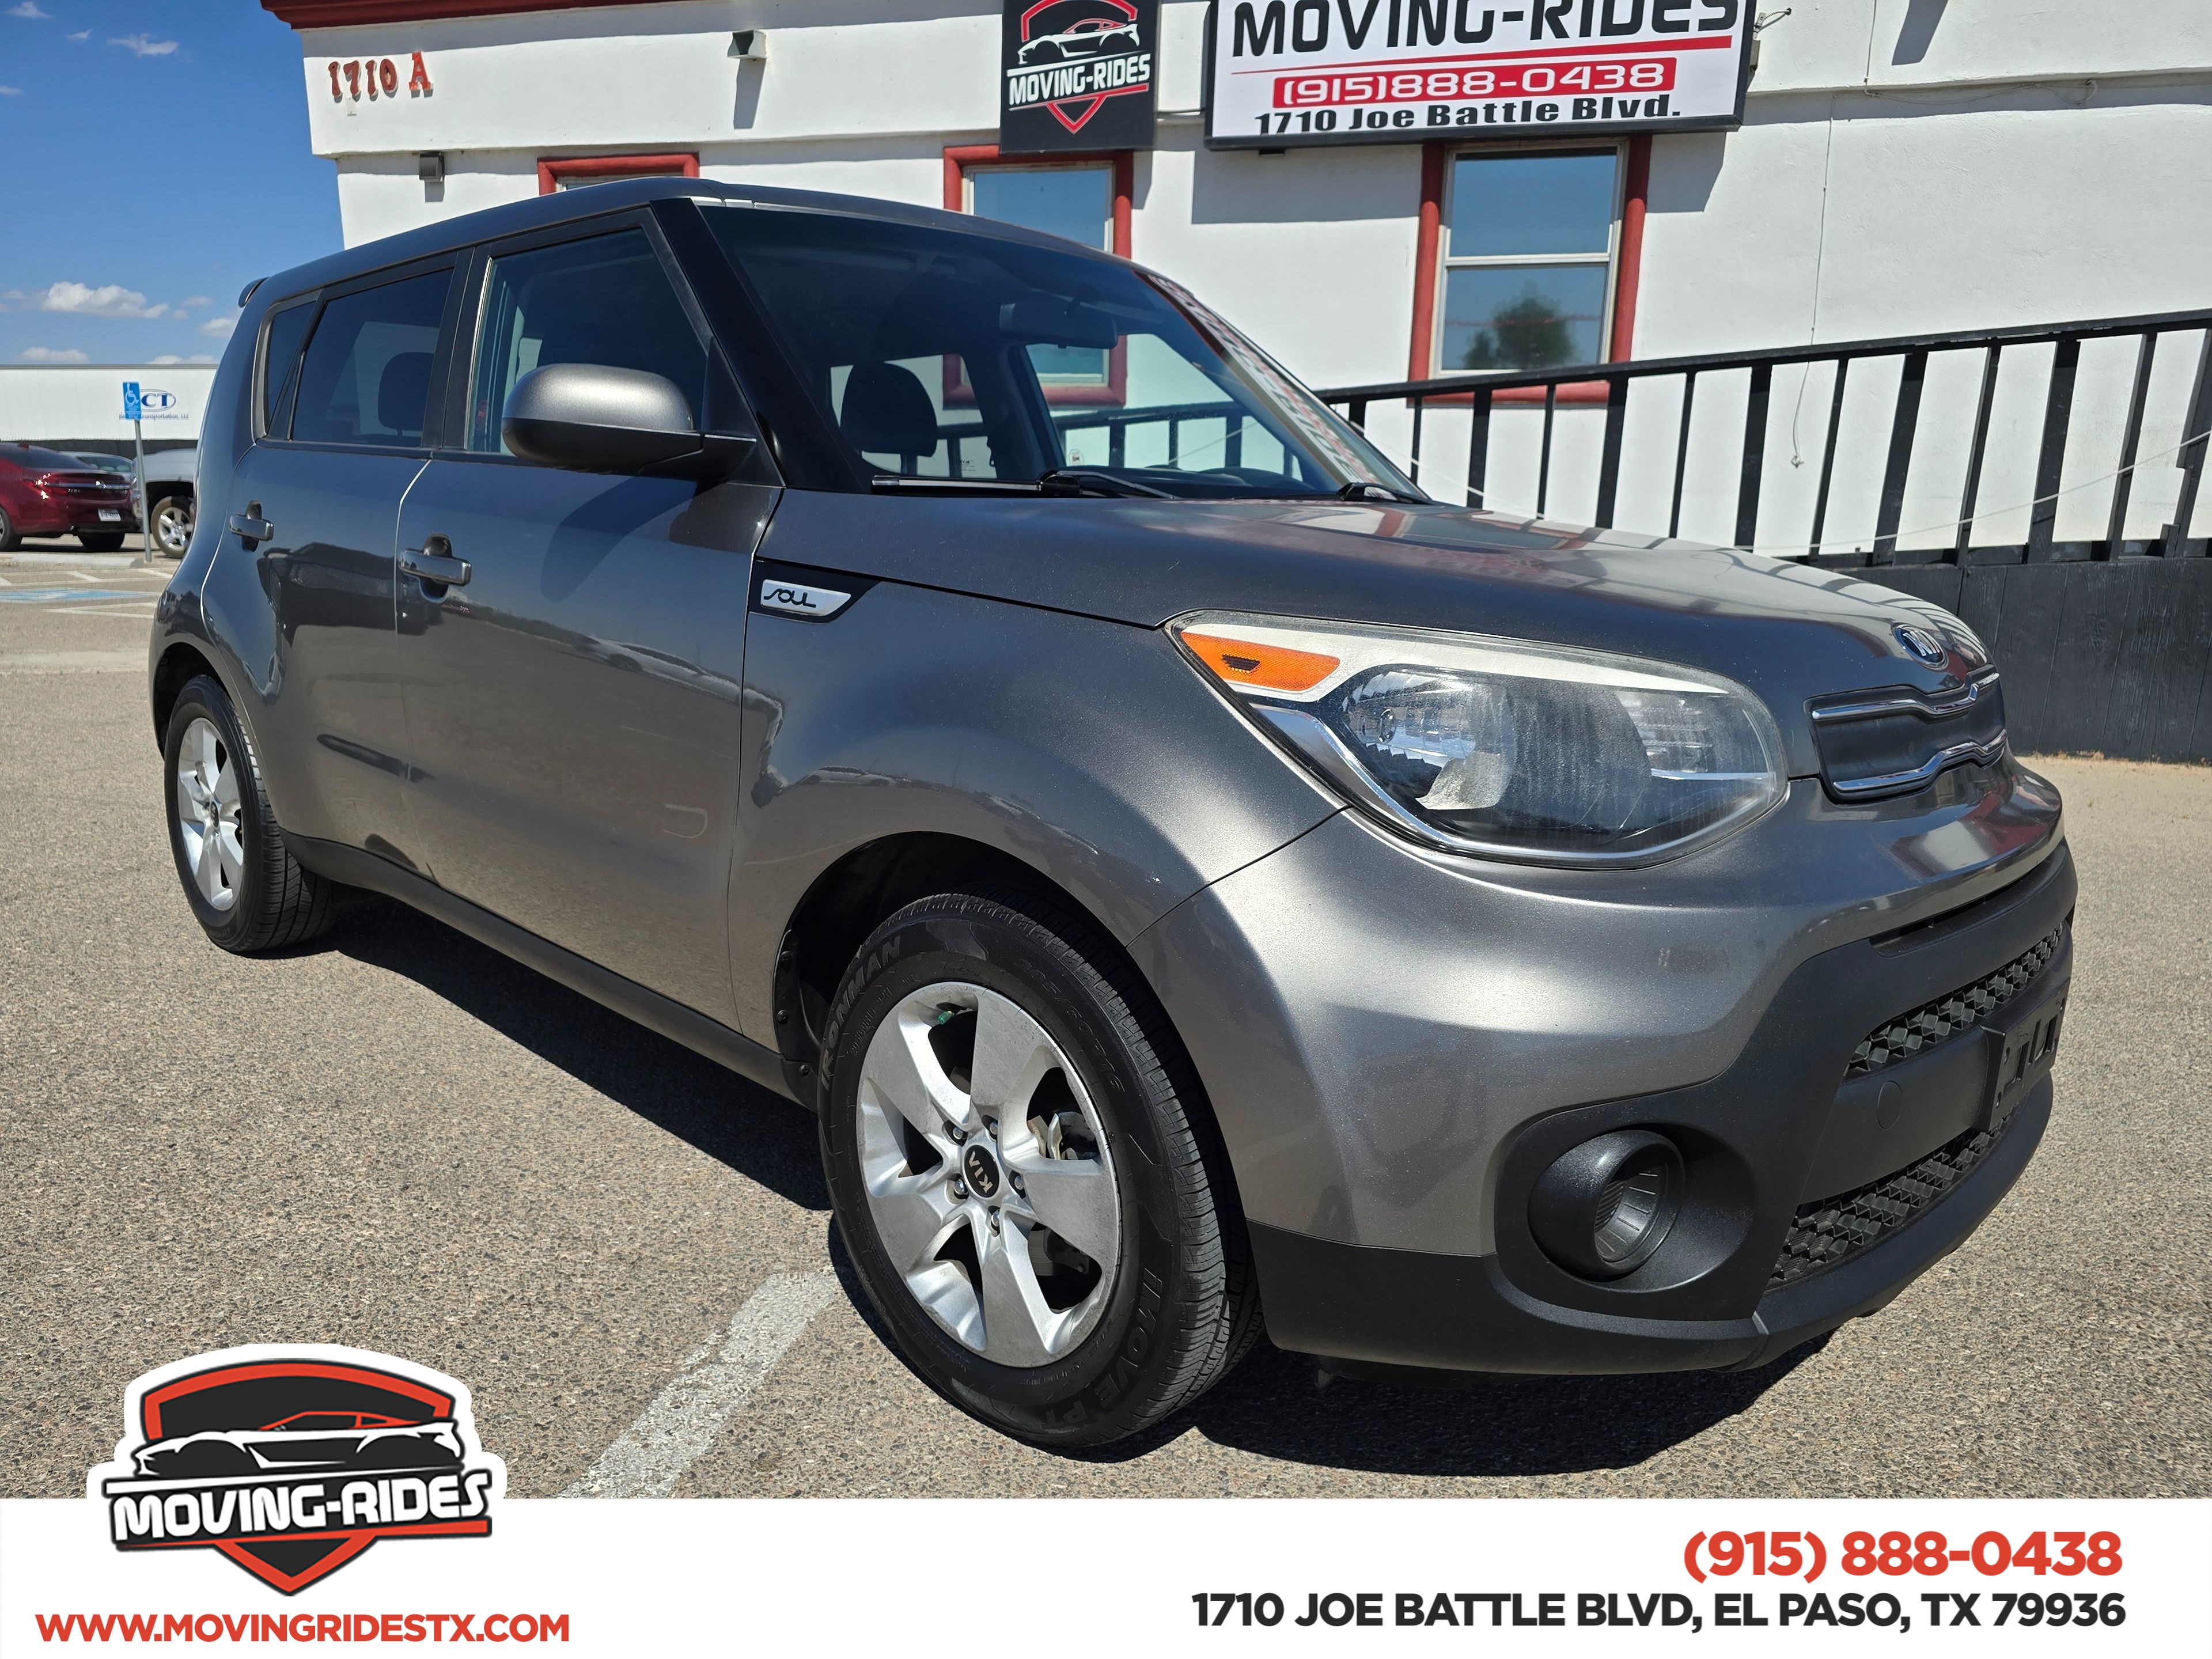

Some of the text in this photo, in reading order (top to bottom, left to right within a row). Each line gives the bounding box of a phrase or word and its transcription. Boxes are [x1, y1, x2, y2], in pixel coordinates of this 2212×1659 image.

[1233, 0, 1738, 57] MOVING-RIDES
[328, 51, 432, 97] 1710 A
[1009, 52, 1151, 106] MOVING-RIDES
[1283, 63, 1664, 104] (915)888-0438
[1255, 94, 1681, 134] 1710 Joe Battle Blvd.
[821, 935, 901, 1092] IRONMAN
[969, 1150, 993, 1194] KIA
